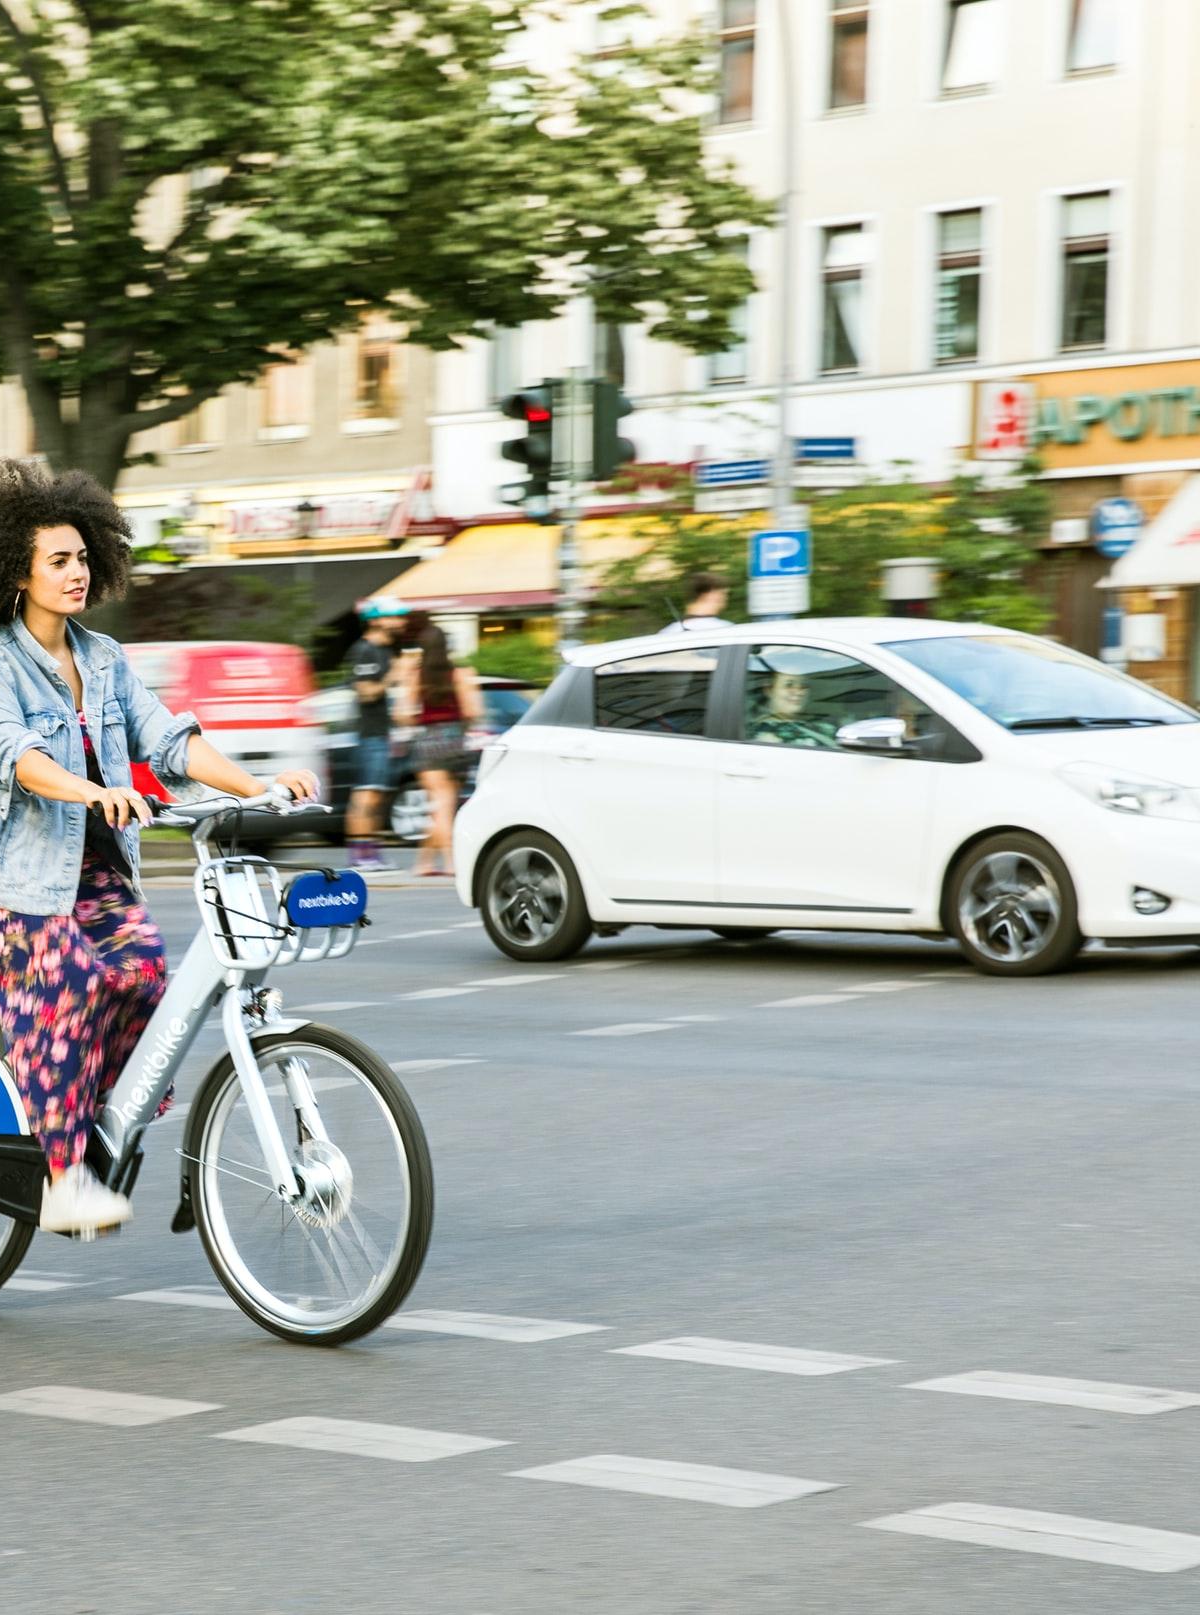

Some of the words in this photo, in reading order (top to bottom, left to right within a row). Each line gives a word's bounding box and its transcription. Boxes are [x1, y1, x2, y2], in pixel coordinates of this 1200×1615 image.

[760, 536, 800, 571] P
[298, 893, 343, 909] nextbike
[122, 1017, 188, 1121] nextbike
